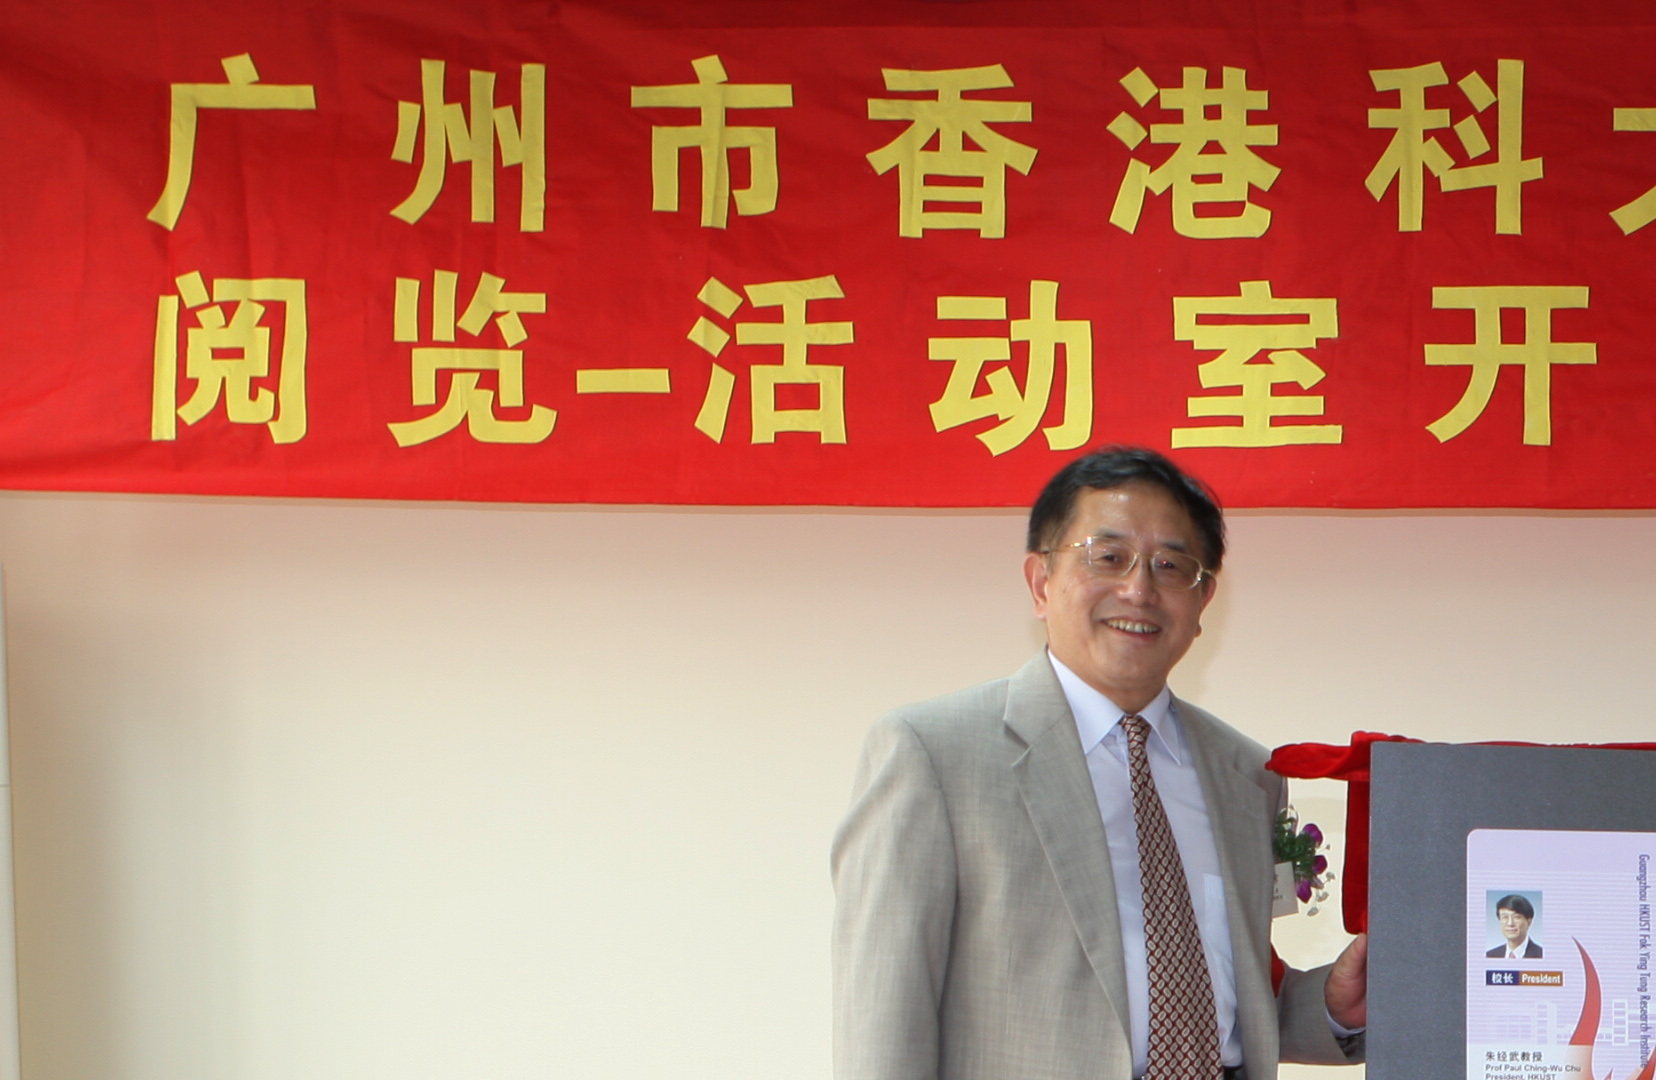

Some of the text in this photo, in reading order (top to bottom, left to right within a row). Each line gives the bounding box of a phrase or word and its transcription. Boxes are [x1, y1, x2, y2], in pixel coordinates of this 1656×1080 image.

[1636, 854, 1652, 1068] Guangzhou HKUST Fok Ying Tung Research Institute
[1522, 973, 1561, 984] President
[1485, 1064, 1582, 1073] Prof Paul Ching-Wu Chu
[1527, 1073, 1557, 1080] HKUST
